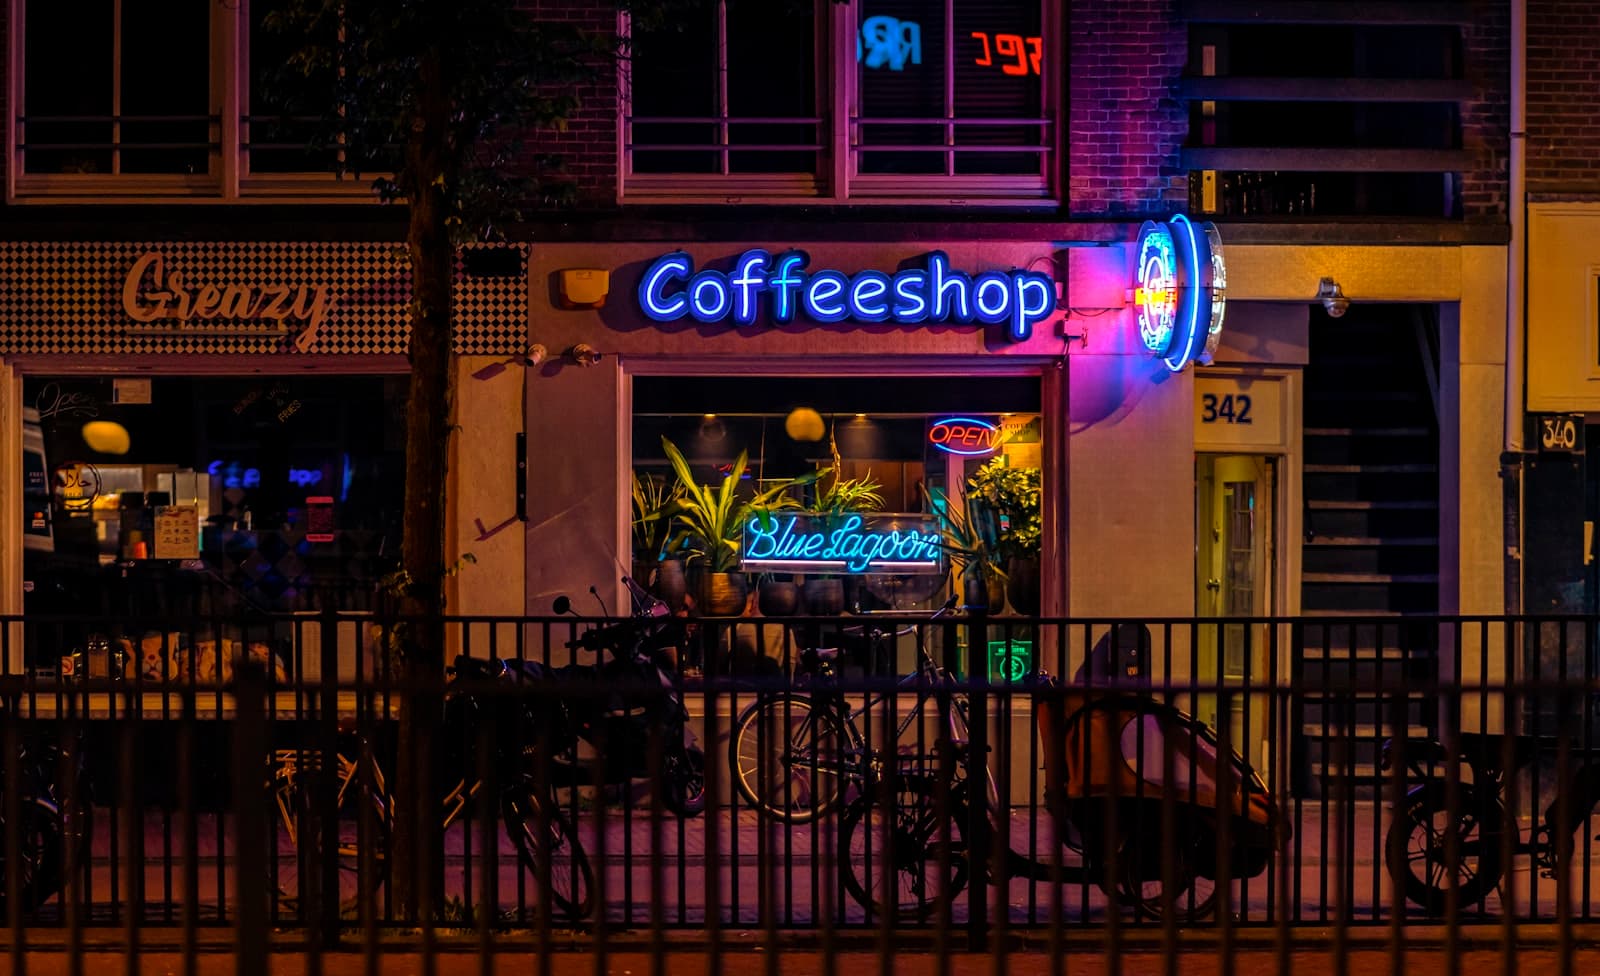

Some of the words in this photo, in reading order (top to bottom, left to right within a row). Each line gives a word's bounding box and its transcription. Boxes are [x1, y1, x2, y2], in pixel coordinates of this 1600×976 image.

[122, 252, 335, 351] Greazy
[641, 250, 1054, 341] Coffeeshop
[1202, 394, 1252, 423] 342
[929, 425, 998, 447] OPEN
[1543, 419, 1576, 449] 340
[747, 516, 825, 558] Blue
[823, 515, 939, 573] Lagoon
